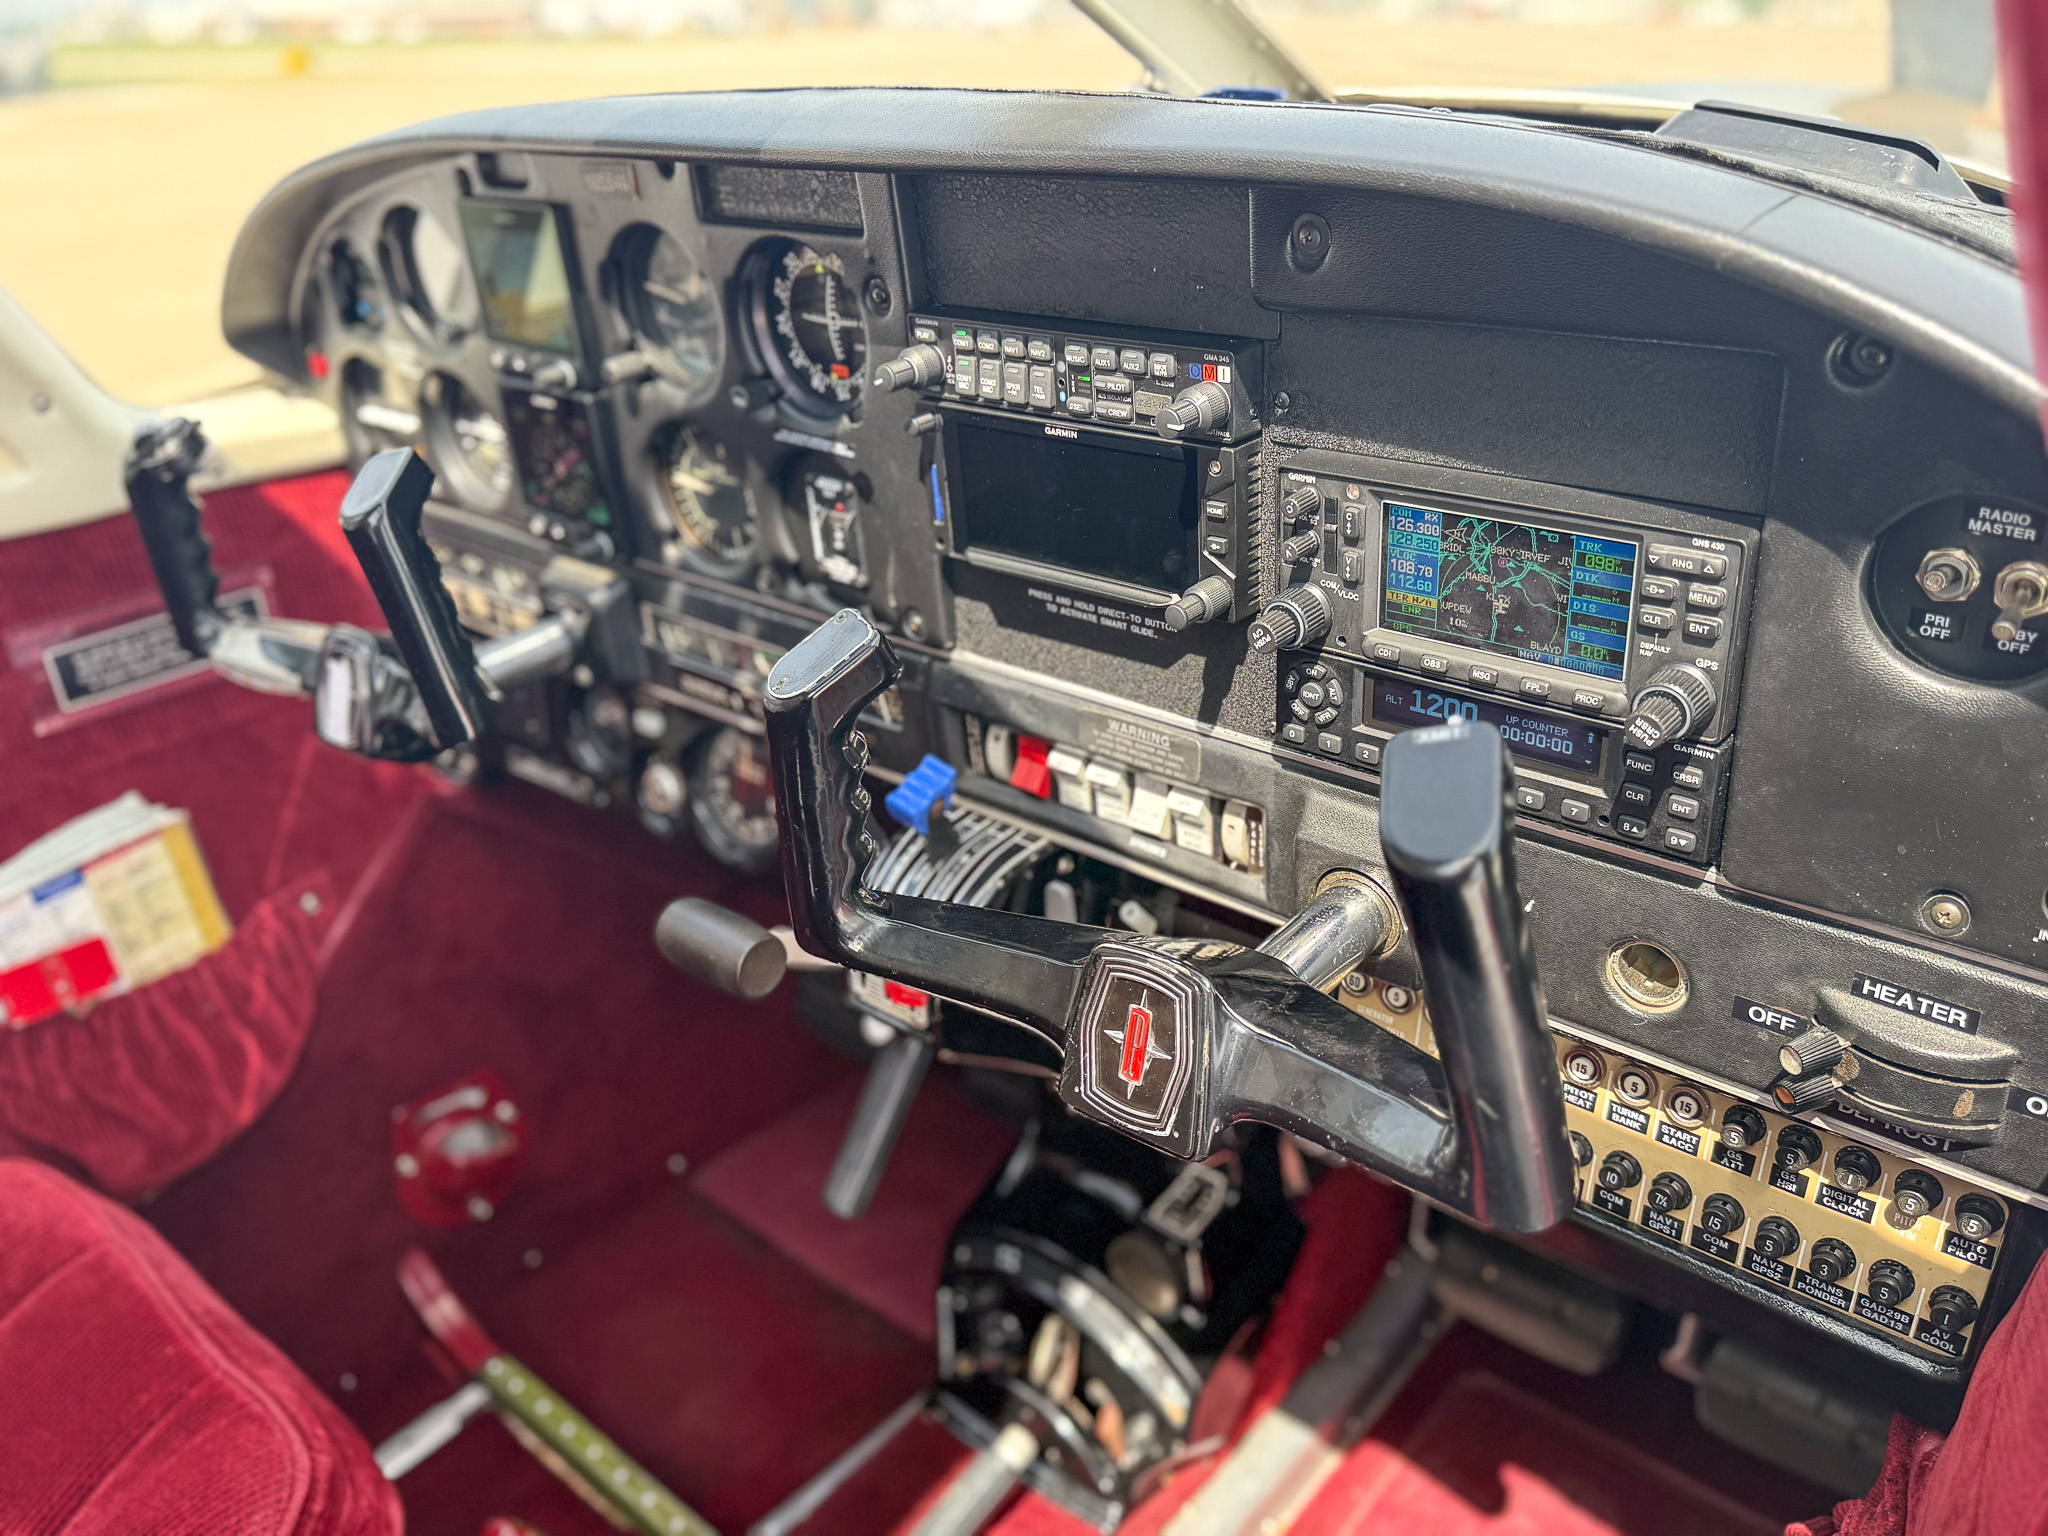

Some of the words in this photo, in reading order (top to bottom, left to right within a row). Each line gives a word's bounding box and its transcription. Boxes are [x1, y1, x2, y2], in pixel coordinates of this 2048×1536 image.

[916, 331, 930, 339] PLAY
[953, 338, 969, 347] COM1
[978, 342, 994, 350] COM2
[1004, 345, 1018, 354] NAV1
[1065, 355, 1085, 363] MUSIC
[1095, 358, 1110, 367] AUX1
[1204, 354, 1218, 362] GMA
[1219, 355, 1229, 363] 345
[1123, 362, 1139, 371] AUX2
[1204, 366, 1215, 378] M
[1107, 383, 1125, 391] PILOT
[1109, 408, 1127, 418] CREW
[1045, 426, 1078, 439] GARMIN
[1288, 472, 1316, 484] GARMIN
[1392, 507, 1411, 518] COM
[1424, 512, 1439, 523] RX
[1979, 506, 2032, 527] RADIO
[1390, 515, 1440, 537] 126.300
[1968, 518, 2037, 542] MASTER
[1389, 531, 1439, 551] 128.250
[1579, 541, 1602, 552] TRK
[1692, 538, 1710, 549] GNS
[1711, 541, 1725, 552] 430
[1391, 550, 1416, 561] VLOC
[1391, 558, 1433, 578] 108.70
[1585, 554, 1616, 572] 098
[1672, 559, 1693, 570] RNG
[1391, 573, 1432, 593] 112.60
[1576, 571, 1598, 583] DTK
[1320, 579, 1359, 601] COM/VLOC
[1390, 591, 1408, 602] TER
[1412, 597, 1432, 607] N/A
[1689, 592, 1718, 605] MENU
[1028, 588, 1053, 601] PRESS
[1056, 595, 1072, 606] AND
[1074, 600, 1095, 612] HOLD
[1098, 605, 1142, 624] DIRECT-TO
[1145, 617, 1178, 633] BUTTO
[1402, 605, 1421, 616] ENR
[1573, 602, 1596, 613] DIS
[1046, 603, 1057, 613] TO
[1060, 607, 1098, 624] ACTIVATE
[1101, 617, 1127, 631] SMART
[1643, 614, 1661, 625] CLR
[1924, 613, 1950, 628] PRI
[1393, 622, 1412, 633] GPS
[1689, 624, 1710, 635] ENT
[1919, 625, 1951, 640] OFF
[1254, 634, 1271, 650] PUSH
[1570, 631, 1585, 641] GS
[1378, 648, 1391, 657] CDI
[1530, 641, 1561, 654] BLAYD
[1640, 642, 1671, 654] DEFAULT
[1640, 649, 1653, 657] NAV
[1997, 640, 2031, 655] OFF
[1519, 650, 1540, 661] NAV
[1424, 658, 1441, 669] OBS
[1695, 658, 1719, 671] GPS
[1305, 668, 1318, 677] ON
[1472, 669, 1490, 681] MSG
[1286, 675, 1295, 690] SBY
[1525, 681, 1542, 692] FPL
[1302, 690, 1320, 701] IDNT
[1328, 687, 1338, 702] ALT
[1385, 694, 1404, 705] ALT
[1574, 693, 1598, 706] PROC
[1291, 703, 1305, 716] OFF
[1409, 689, 1479, 722] 1200
[1317, 711, 1332, 723] VFR
[1505, 715, 1519, 725] UP
[1521, 718, 1568, 738] COUNTER
[1635, 716, 1660, 739] CRSR
[1108, 719, 1171, 748] WARNING
[1628, 724, 1655, 747] PUSH
[1363, 750, 1369, 758] 2
[1673, 743, 1714, 760] GARMIN
[1626, 758, 1652, 772] FUNC
[1673, 771, 1699, 785] CRSR
[1525, 795, 1533, 804] 6
[1625, 790, 1644, 801] CLR
[1570, 807, 1578, 816] 7
[1672, 803, 1692, 815] ENT
[1393, 992, 1400, 1002] 5
[1861, 979, 1969, 1029] HEATER
[1357, 1004, 1395, 1025] GENERATOR
[1747, 1005, 1797, 1032] OFF
[1575, 1062, 1588, 1075] 15
[1563, 1083, 1596, 1101] PITOT
[1630, 1082, 1639, 1093] 5
[1564, 1094, 1593, 1109] HEAT
[1679, 1101, 1692, 1114] 15
[1611, 1103, 1647, 1123] TURN&
[1611, 1114, 1642, 1131] BANK
[1661, 1125, 1699, 1145] START
[1730, 1132, 1739, 1144] 5
[1661, 1135, 1695, 1153] &ACC
[1726, 1149, 1742, 1161] G5
[1786, 1153, 1794, 1165] 5
[1720, 1157, 1745, 1171] ATT
[1605, 1170, 1618, 1185] 10
[1780, 1170, 1797, 1182] G5
[1776, 1178, 1797, 1193] HSI
[1599, 1189, 1624, 1206] COM
[1822, 1186, 1870, 1211] DIGITAL
[1822, 1196, 1866, 1219] CLOCK
[1905, 1198, 1917, 1211] 5
[1650, 1210, 1679, 1229] NAV1
[1708, 1215, 1722, 1231] 15
[1893, 1212, 1922, 1231] PITCH
[1966, 1219, 1979, 1233] 5
[1648, 1220, 1677, 1237] GPS1
[1702, 1232, 1729, 1250] COM
[1764, 1239, 1774, 1252] 5
[1950, 1235, 1987, 1255] AUTO
[1709, 1244, 1717, 1254] 2
[1947, 1246, 1987, 1265] PILOT
[1752, 1253, 1785, 1273] NAV2
[1751, 1263, 1782, 1282] GPS2
[1820, 1264, 1829, 1276] 3
[1804, 1275, 1844, 1298] TRANS
[1879, 1286, 1889, 1299] 5
[1797, 1281, 1847, 1308] PONDER
[1860, 1297, 1910, 1325] GAD29B
[1862, 1310, 1904, 1332] GAD13
[1920, 1332, 1957, 1354] COOL
